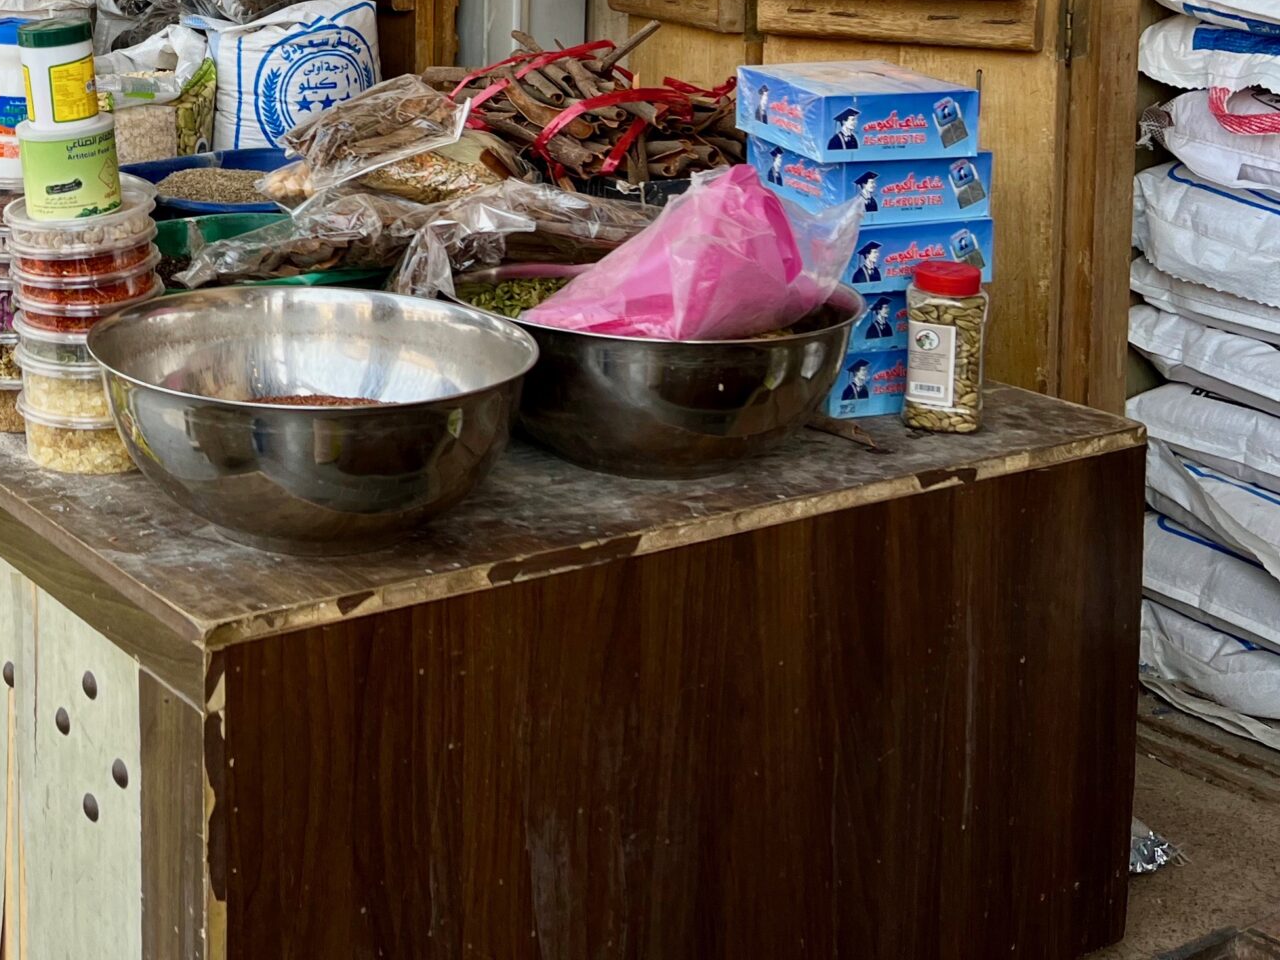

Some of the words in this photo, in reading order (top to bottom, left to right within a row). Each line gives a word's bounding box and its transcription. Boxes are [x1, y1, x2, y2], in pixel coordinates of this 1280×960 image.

[279, 37, 331, 63] سعودي
[328, 61, 349, 74] درجة
[297, 76, 338, 95] كيلو
